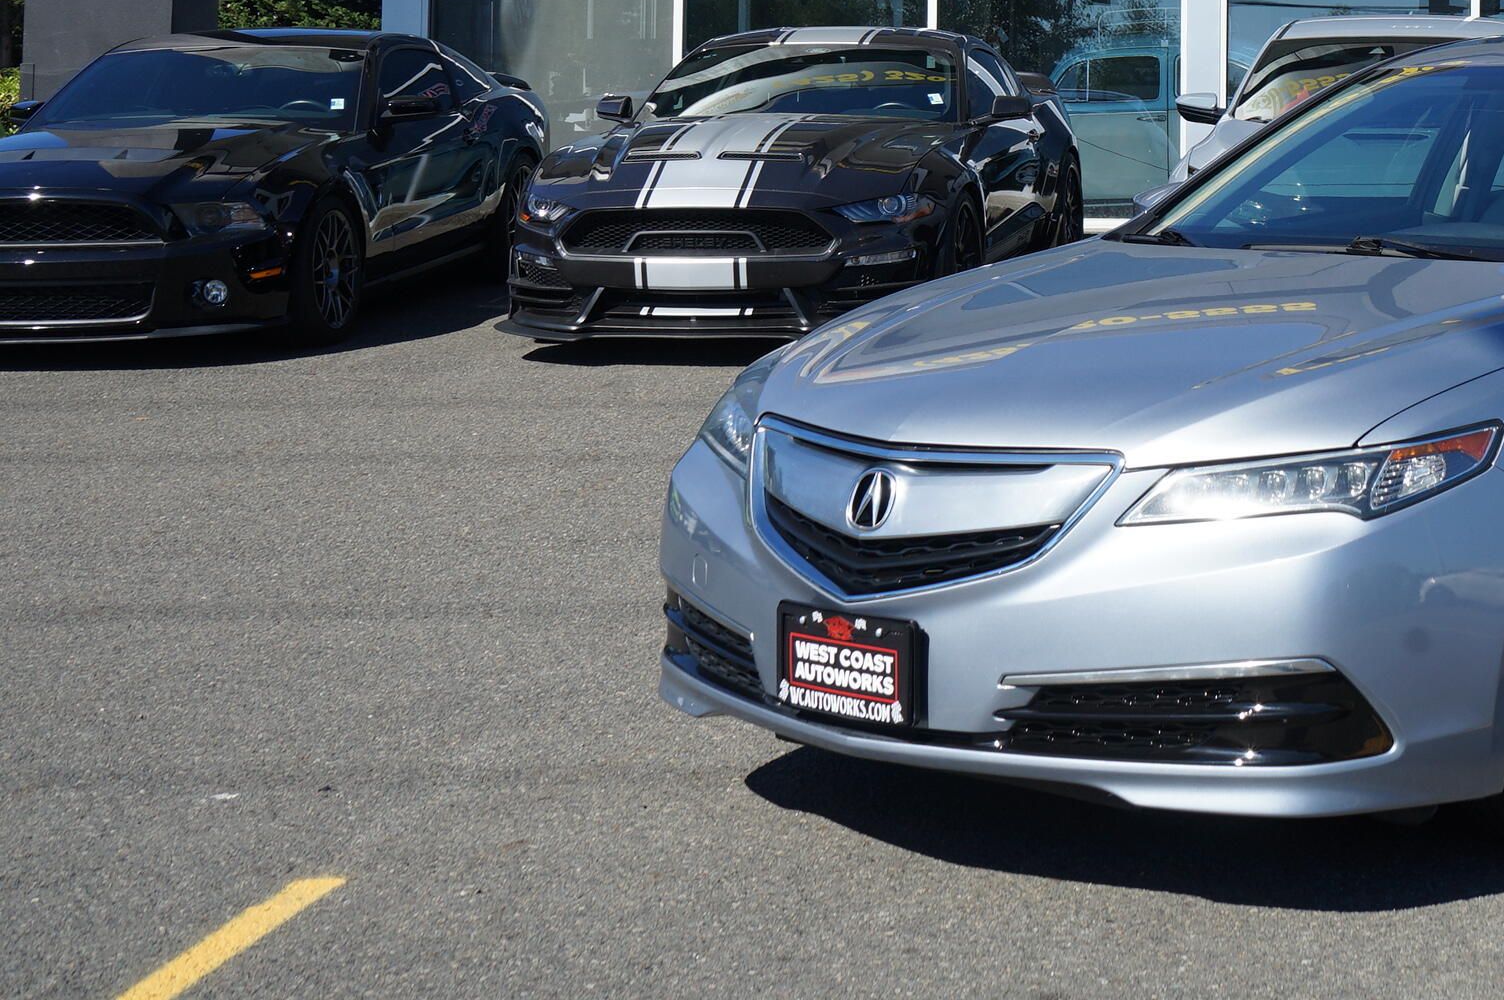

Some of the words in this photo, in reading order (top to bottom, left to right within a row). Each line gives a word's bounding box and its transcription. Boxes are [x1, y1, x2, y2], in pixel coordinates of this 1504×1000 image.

[795, 640, 837, 665] WEST
[839, 649, 894, 674] COAST
[795, 662, 894, 696] AUTOWORKS
[789, 685, 891, 723] WCAUTOWORKS.COM
